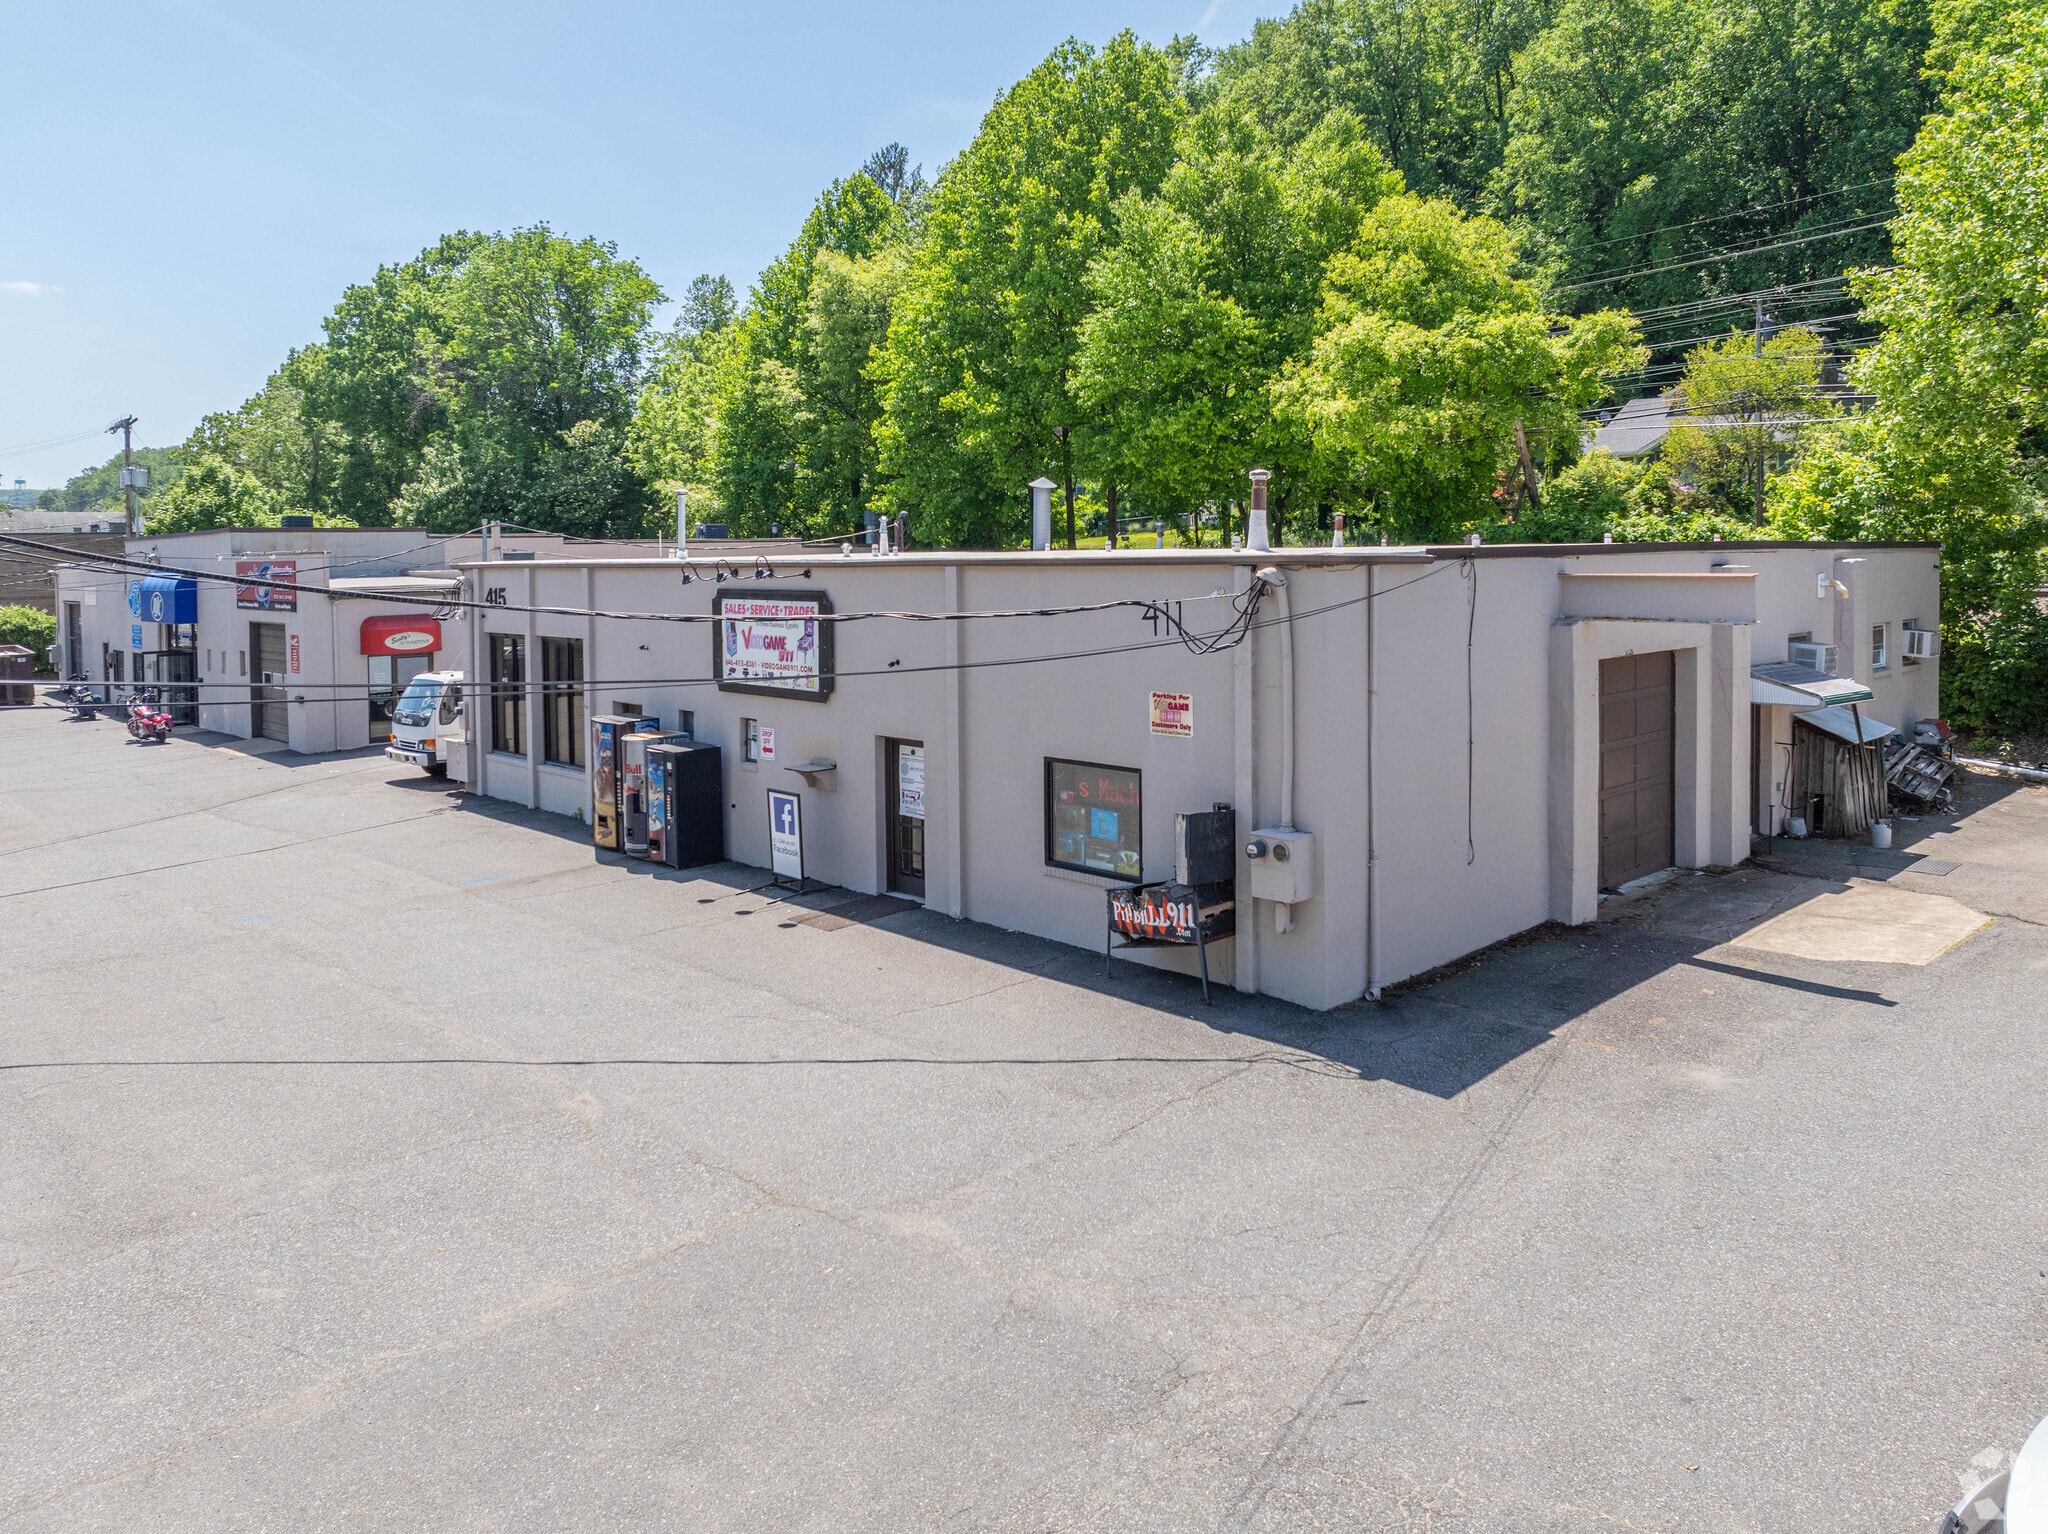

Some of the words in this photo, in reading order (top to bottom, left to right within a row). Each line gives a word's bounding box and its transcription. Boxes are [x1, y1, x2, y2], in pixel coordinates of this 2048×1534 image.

[485, 588, 507, 606] 415
[725, 603, 746, 615] SALES
[750, 604, 780, 616] SERVICE
[784, 605, 815, 617] TRADES
[1142, 599, 1183, 637] 411
[778, 651, 793, 661] 911
[761, 662, 813, 673] VIDEOGAME911.COM
[1152, 692, 1177, 701] Parking
[1151, 720, 1178, 729] Customers
[1179, 723, 1192, 732] Only
[624, 763, 642, 775] Bull
[1098, 777, 1140, 806] Mach
[773, 843, 799, 858] Facebook
